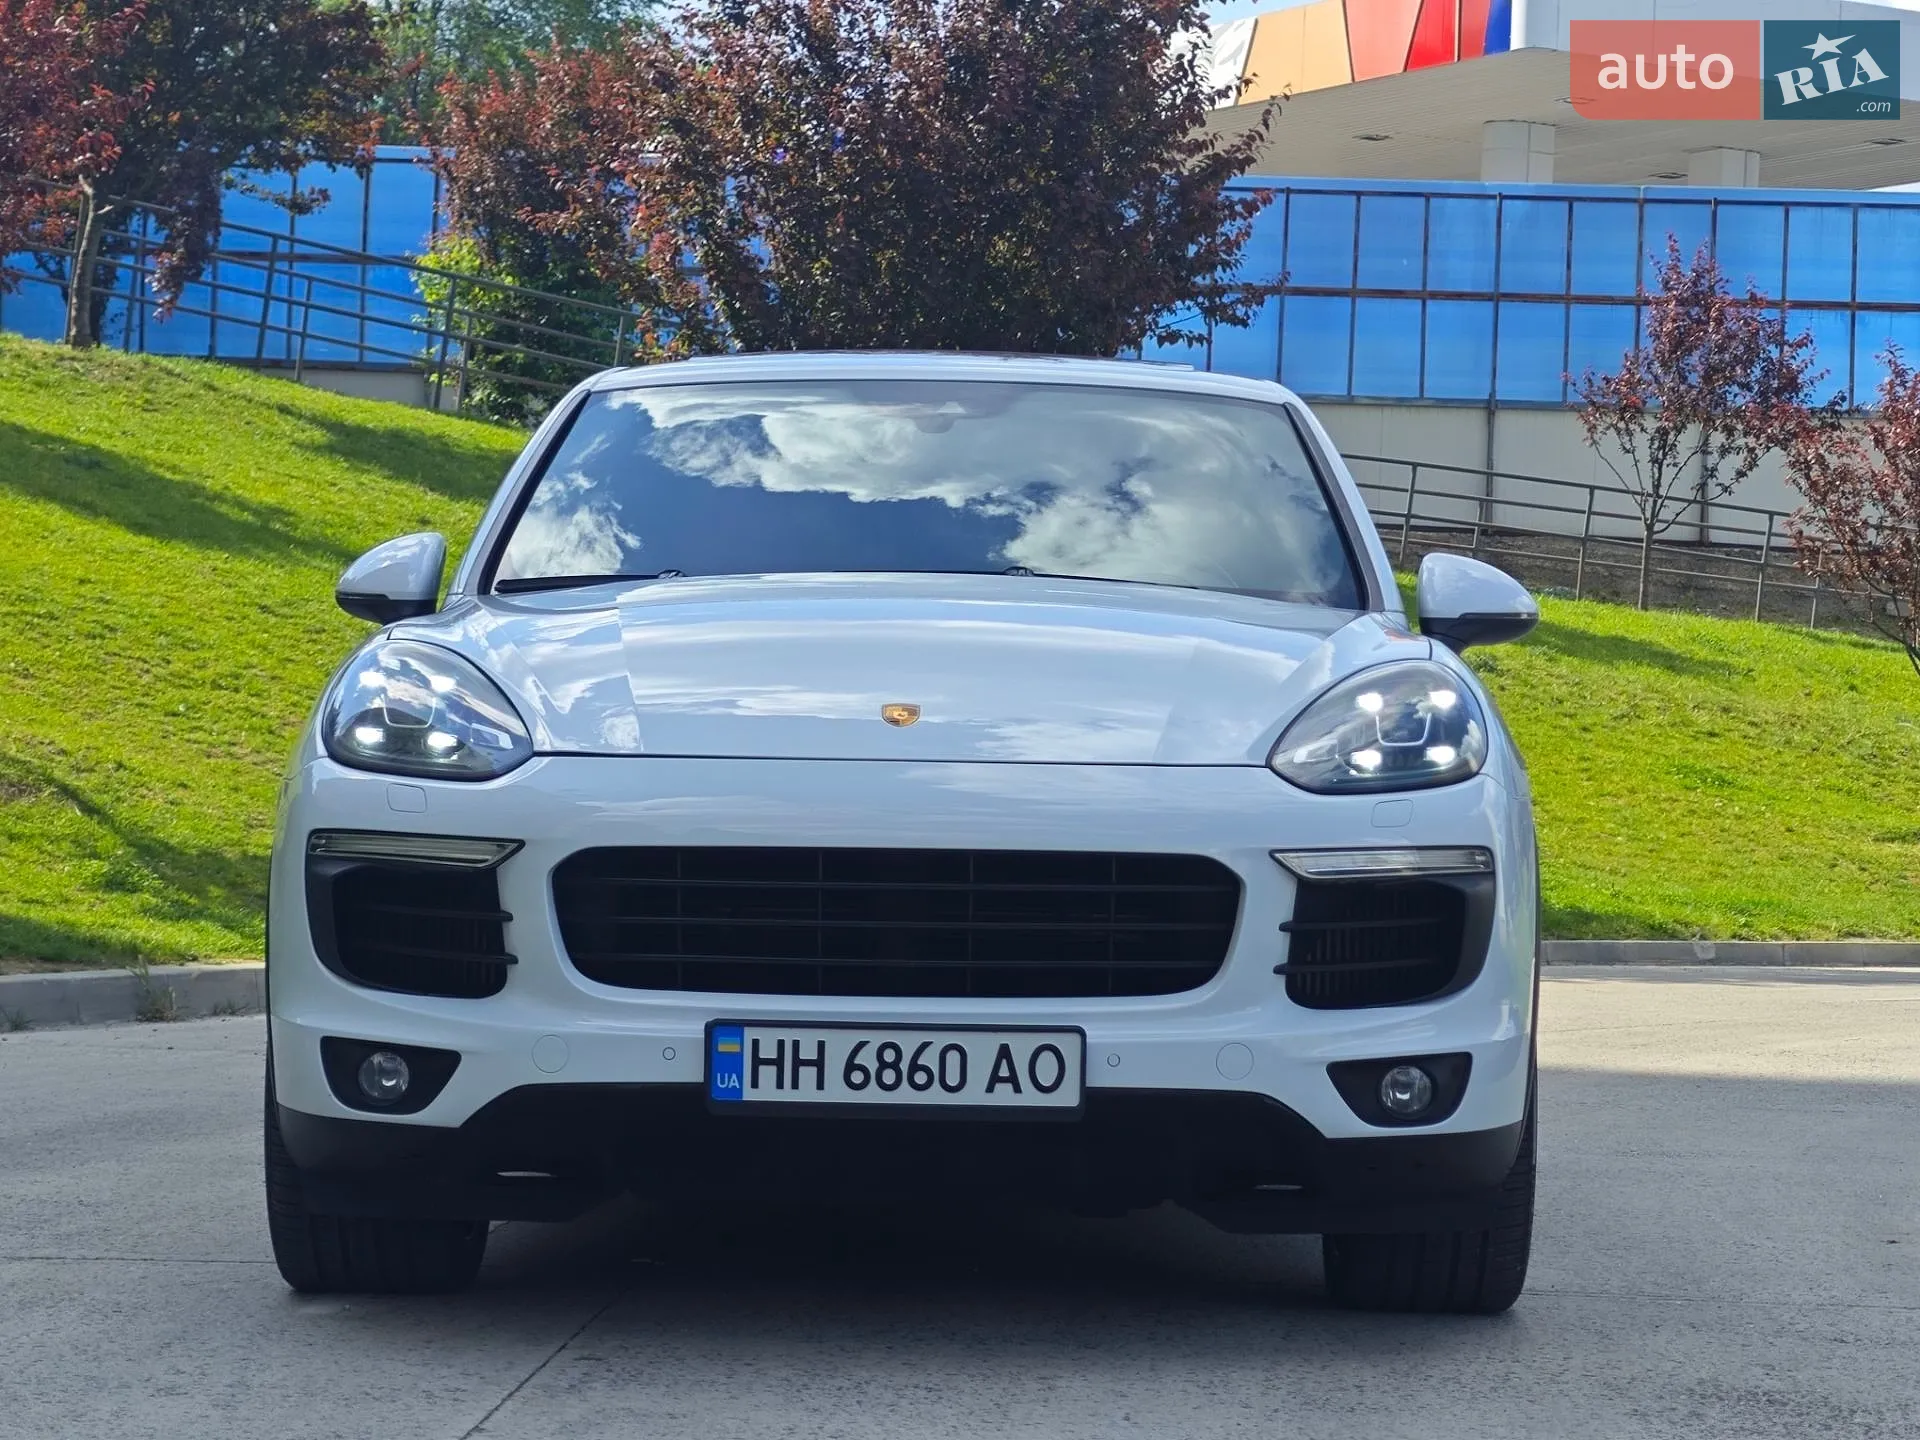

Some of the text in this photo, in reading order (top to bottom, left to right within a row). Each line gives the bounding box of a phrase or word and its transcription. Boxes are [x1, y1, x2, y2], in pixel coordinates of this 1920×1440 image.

[716, 1073, 740, 1089] UA
[750, 1038, 1066, 1094] HH 6860 AO
